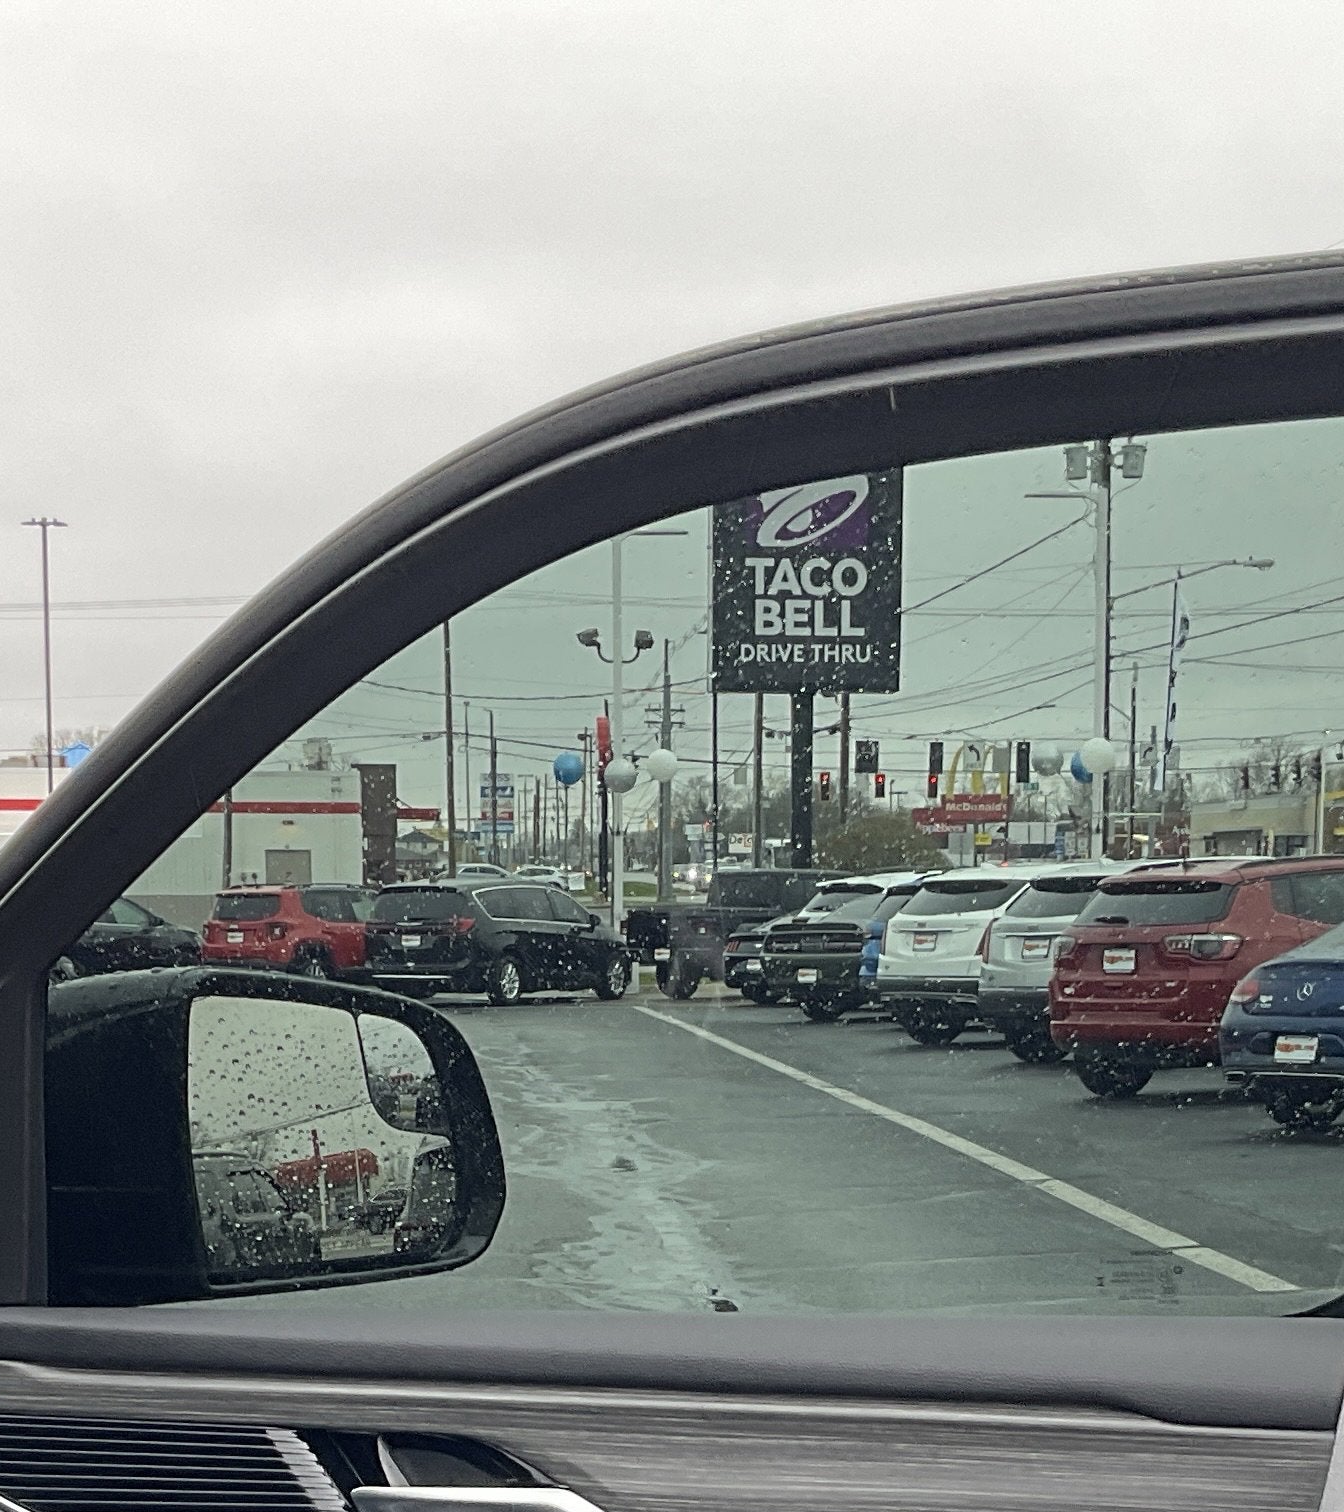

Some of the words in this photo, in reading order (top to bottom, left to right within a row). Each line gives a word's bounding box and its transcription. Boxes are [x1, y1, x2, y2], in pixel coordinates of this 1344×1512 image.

[745, 557, 868, 597] TACO
[755, 599, 866, 637] BELL
[739, 643, 805, 663] DRIVE
[811, 643, 873, 663] THRU
